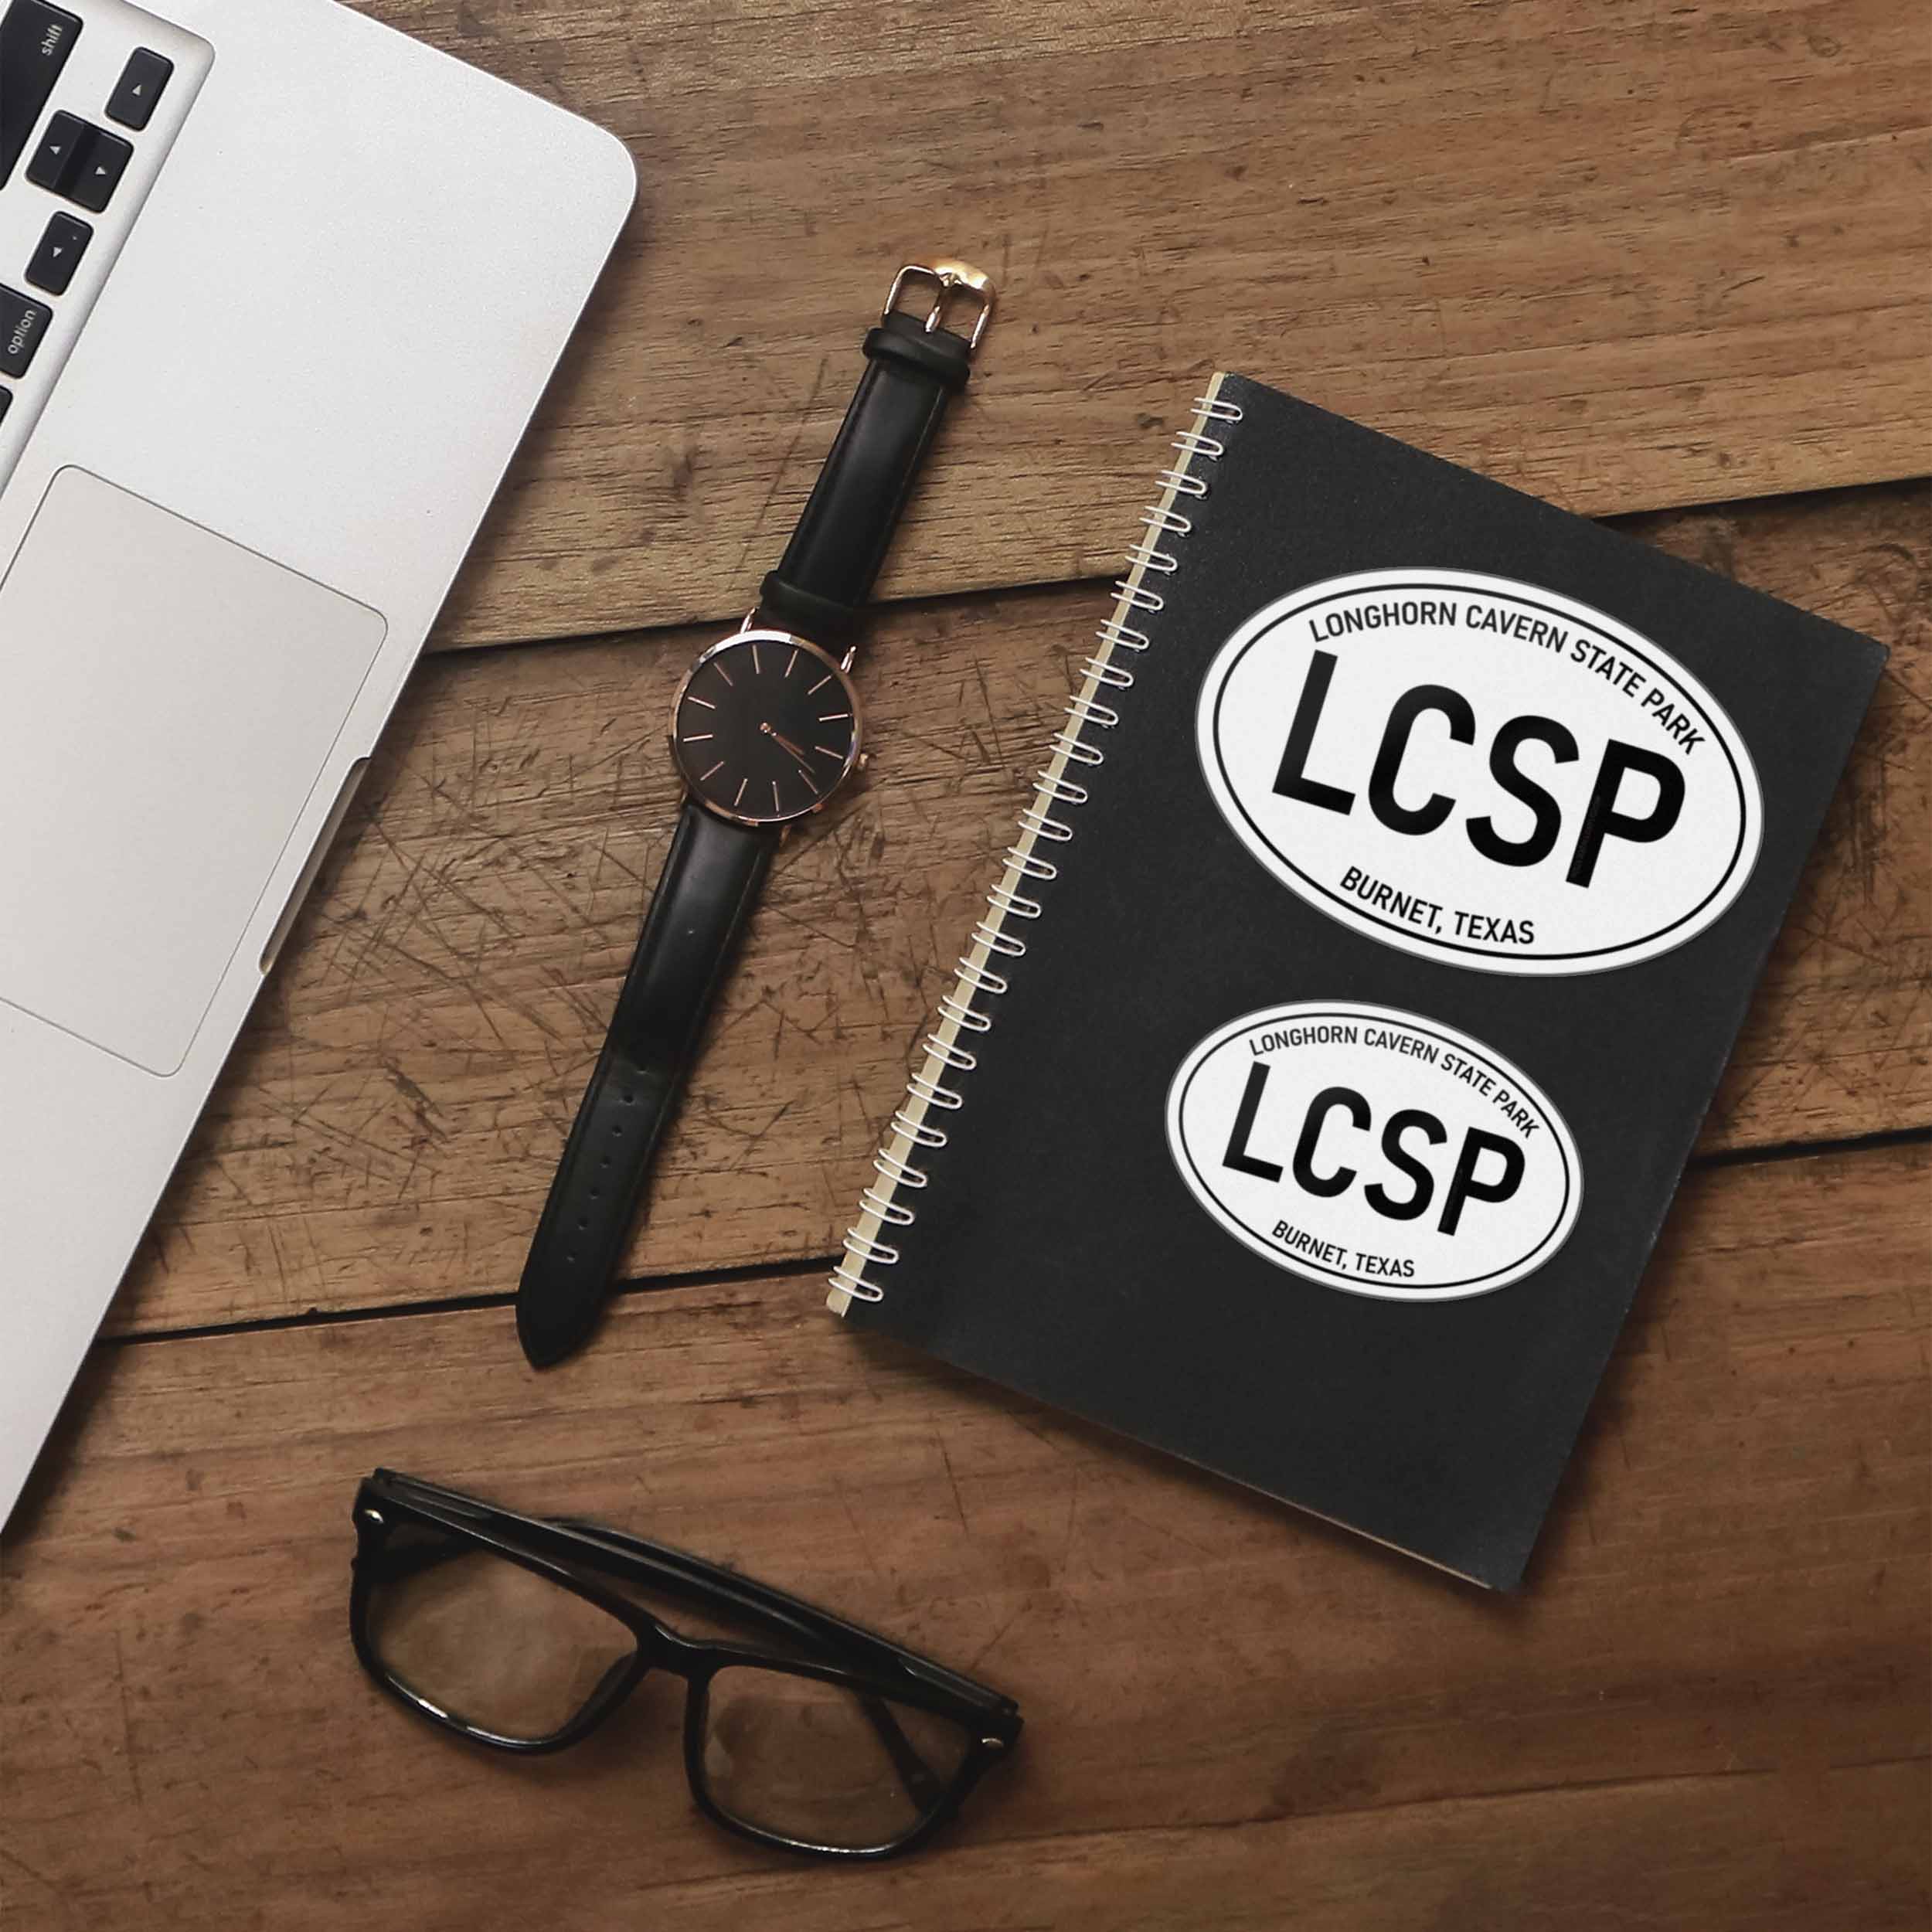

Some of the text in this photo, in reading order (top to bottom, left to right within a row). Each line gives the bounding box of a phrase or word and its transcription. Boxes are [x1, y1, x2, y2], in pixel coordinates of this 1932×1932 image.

[40, 24, 63, 56] shift
[8, 309, 36, 355] option
[1308, 601, 1706, 755] LONGHORN CAVERN STATE PARK
[1271, 649, 1685, 889] LCSP
[1339, 866, 1535, 945] BURNET, TEXAS
[1249, 1026, 1540, 1138] LONGHORN CAVERN STATE PARK
[1222, 1060, 1526, 1236] LCSP
[1271, 1219, 1415, 1277] BURNET, TEXAS
